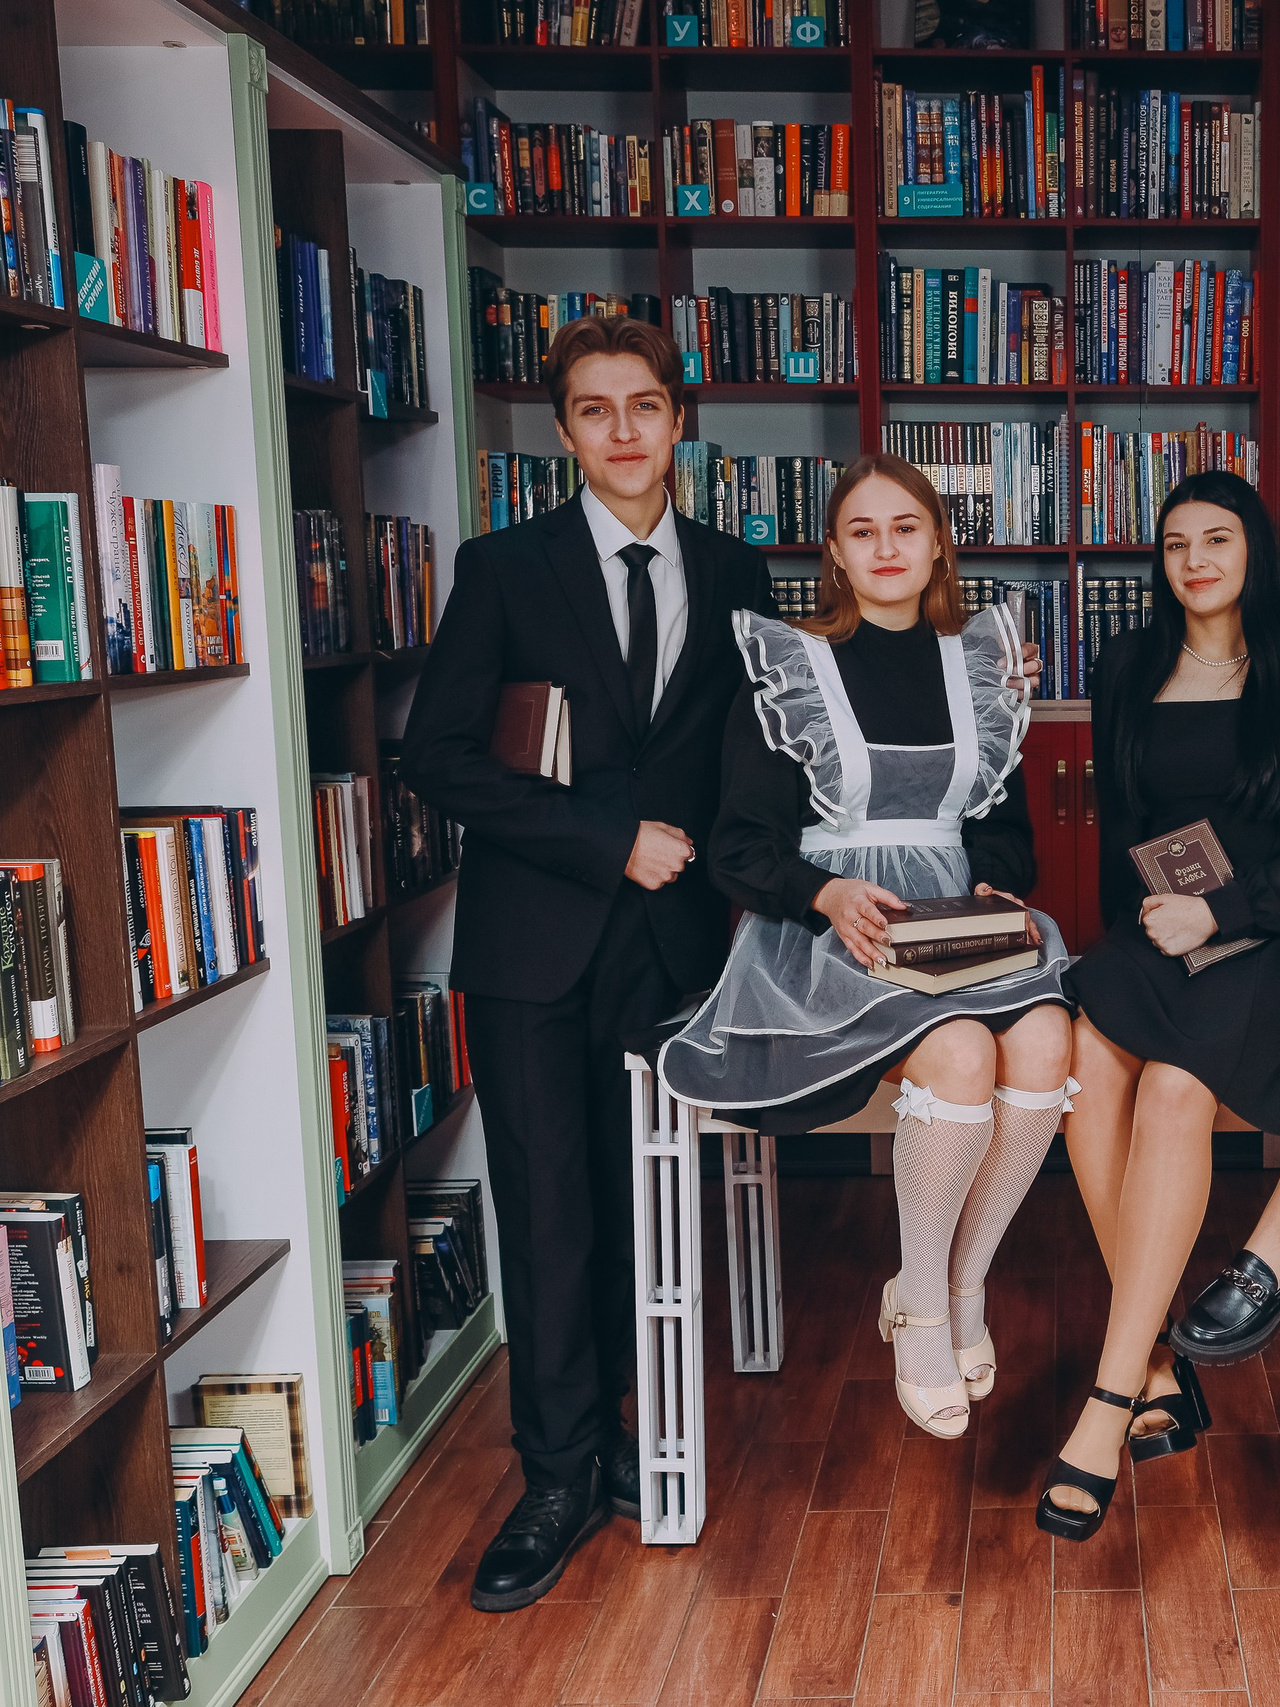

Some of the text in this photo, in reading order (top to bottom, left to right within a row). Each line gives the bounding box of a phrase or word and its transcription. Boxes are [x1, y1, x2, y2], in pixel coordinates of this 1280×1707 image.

[672, 21, 691, 42] У
[796, 21, 820, 43] Ф
[981, 122, 989, 158] ПРИРОДНЫЕ
[468, 188, 487, 209] С
[982, 158, 990, 204] УДИВИТЕЛЬНЫЕ
[682, 190, 703, 211] Х
[903, 196, 911, 205] 9
[916, 203, 952, 211] СОДЕРЖАНИЯ
[84, 277, 104, 313] РОМАН
[1184, 267, 1192, 304] ПРИРОДА
[933, 290, 941, 370] ЭНЦИКЛОПЕДИЯ
[947, 290, 958, 360] БИОЛОГИЯ
[1118, 283, 1127, 371] КРАСНАЯ КНИГА ЗЕМЛИ
[1174, 292, 1182, 373] КРАСНАЯ КНИГА ПТИЦЫ РОССИИ
[1204, 277, 1215, 380] САКРАЛЬНЫЕ МЕСТА ПЛАНЕТЫ
[491, 463, 503, 498] ТЕРРОР
[108, 489, 122, 581] Чужестранка
[751, 519, 769, 540] Э
[64, 525, 73, 583] ПРОЛОГ
[131, 549, 141, 590] ТИШИНА
[135, 590, 143, 619] МОИХ
[1174, 862, 1202, 878] Франц
[1177, 870, 1207, 887] КАФКА
[189, 878, 202, 953] ПРИГОВОРЕННЫЙ ДАР
[35, 879, 54, 994] АЛТАРЬ ПОБЕДЫ
